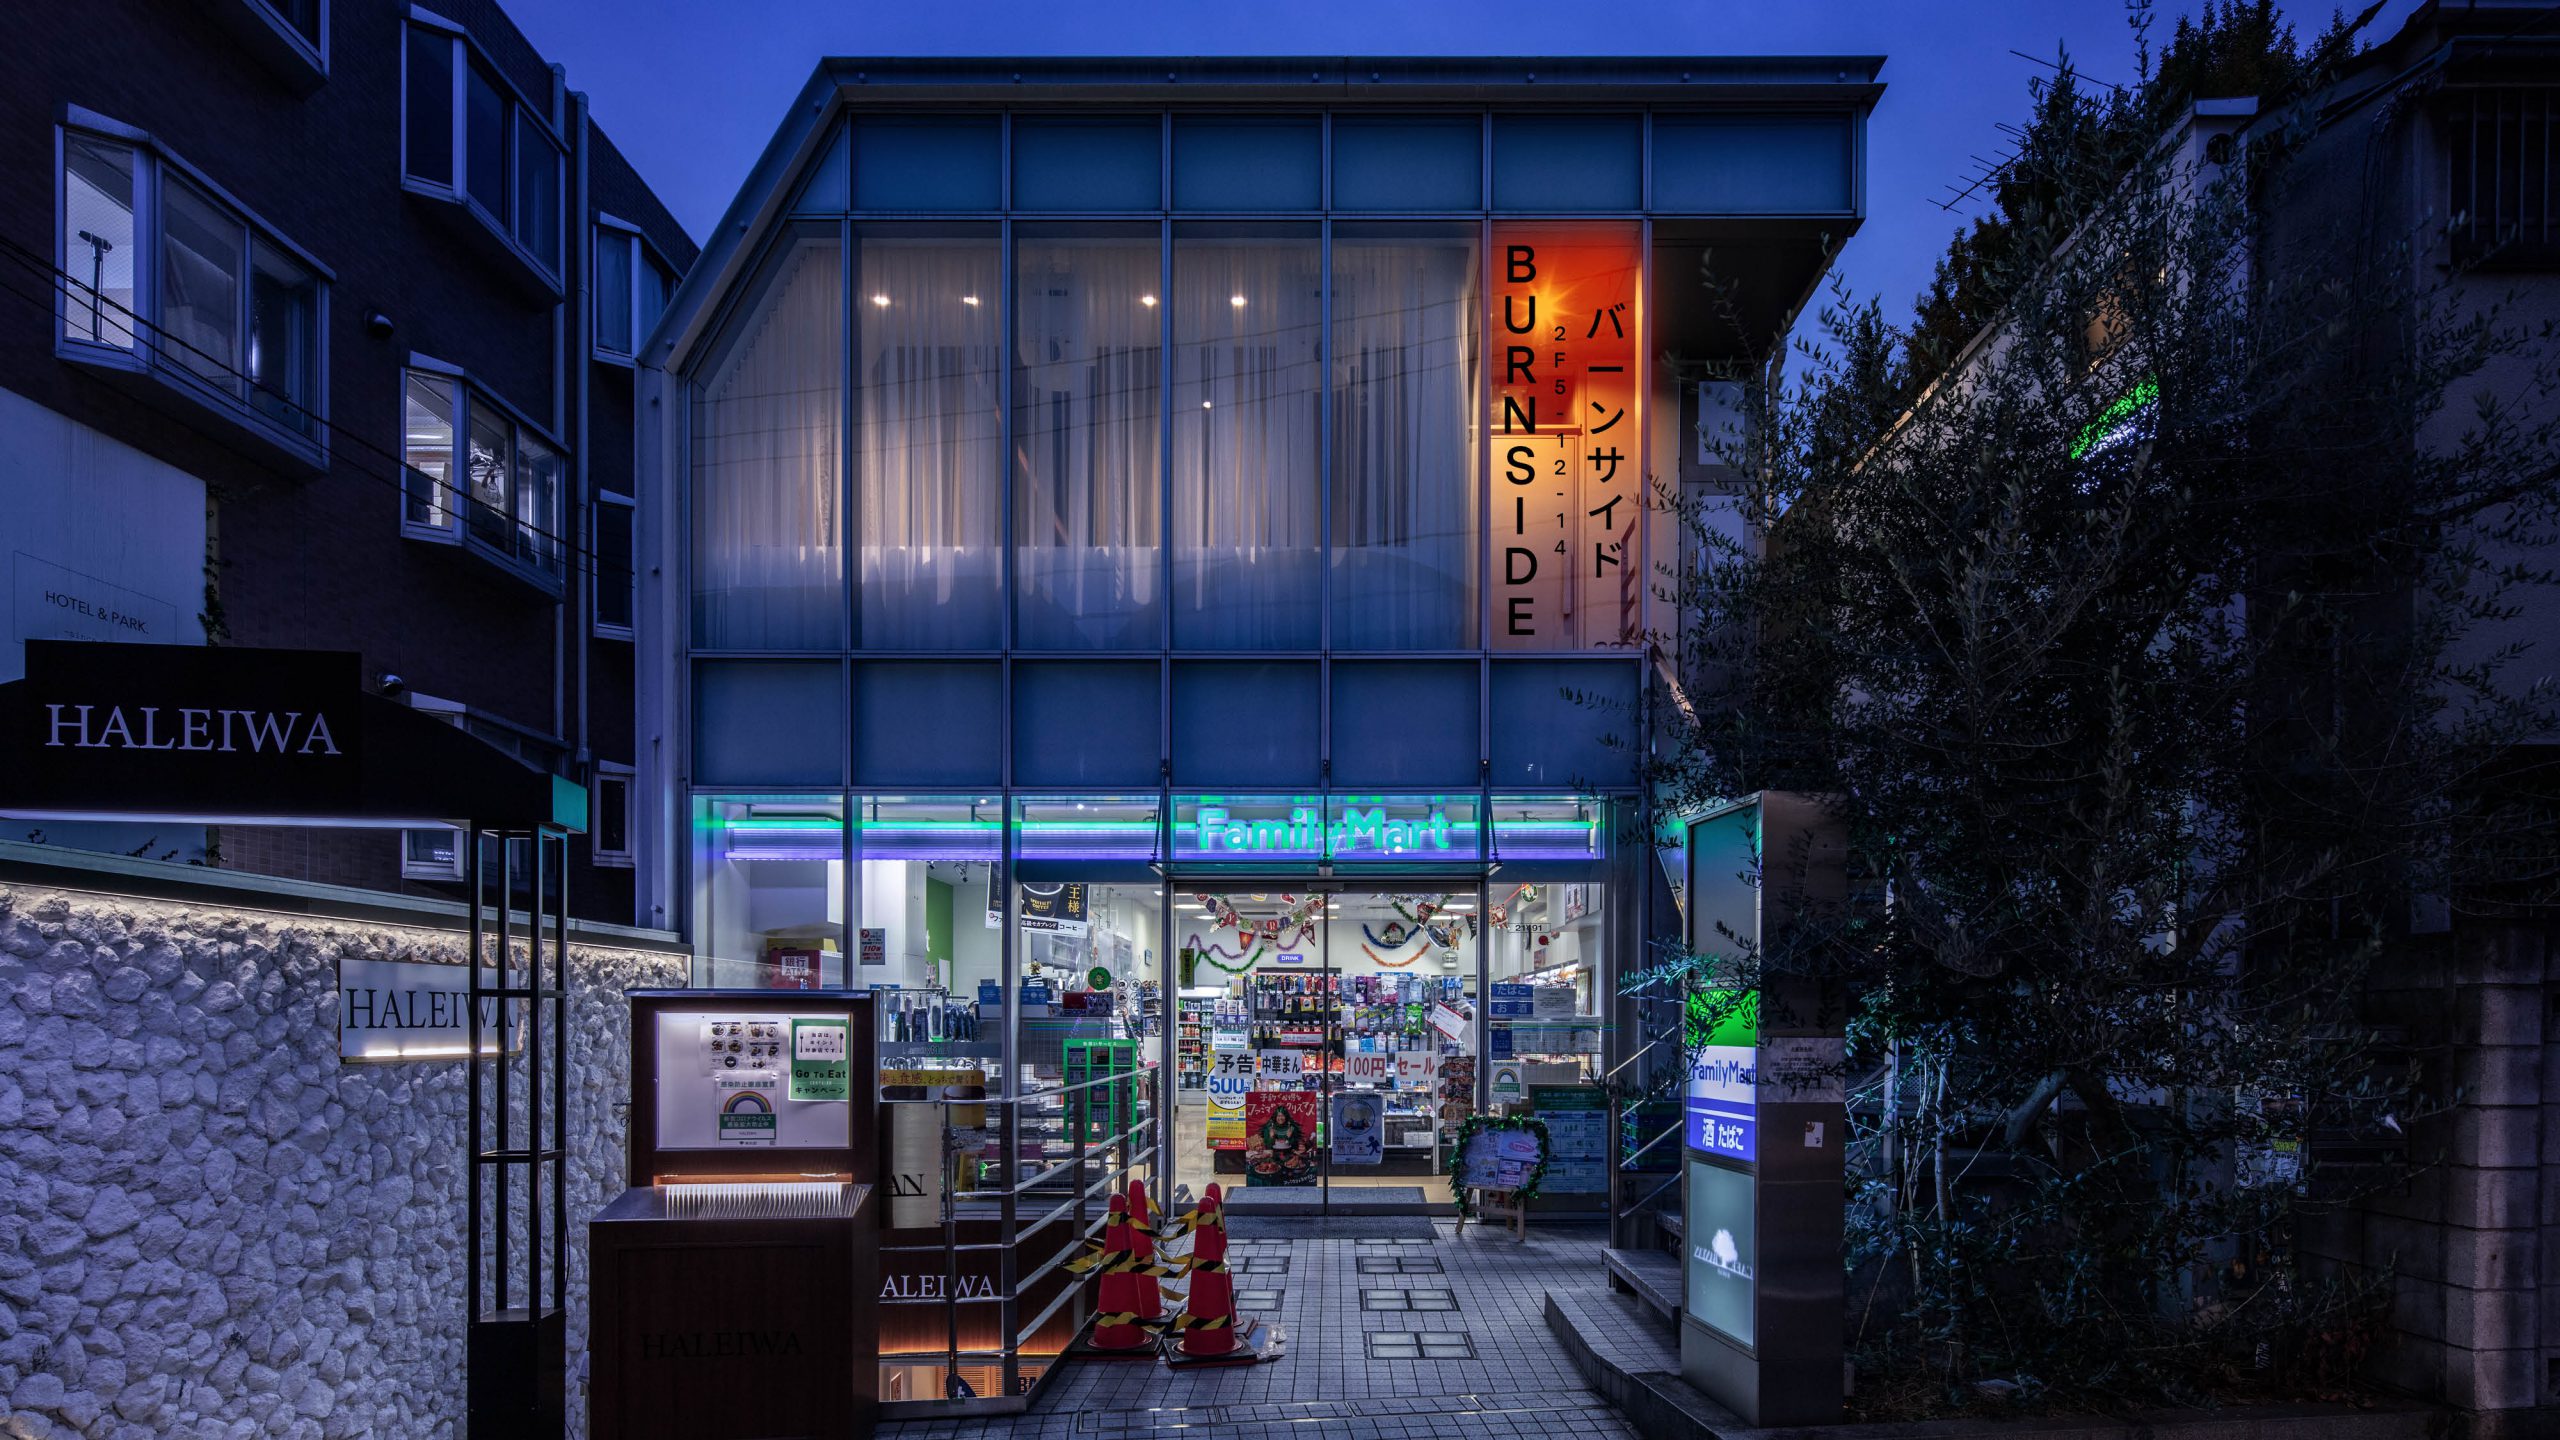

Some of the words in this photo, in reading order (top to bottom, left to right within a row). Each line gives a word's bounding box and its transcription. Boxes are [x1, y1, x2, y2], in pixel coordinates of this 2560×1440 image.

[1504, 245, 1537, 636] BURNSIDE
[1586, 302, 1626, 579] バーンサイド
[45, 590, 94, 618] HOTEL
[98, 607, 108, 620] &
[43, 703, 343, 756] HALEIWA
[1199, 808, 1450, 857] FamilyMart
[784, 957, 806, 967] 銀行
[785, 968, 806, 976] ATM
[1497, 985, 1528, 996] たばこ
[1217, 1053, 1255, 1074] 予告
[1262, 1055, 1301, 1074] 中華まん
[1347, 1057, 1386, 1077] 100円
[1397, 1056, 1435, 1075] セール
[796, 1070, 809, 1078] Go
[828, 1070, 846, 1078] Eat
[795, 1086, 845, 1094] キャンペーン
[1703, 1117, 1715, 1148] 酒
[1718, 1123, 1744, 1151] たばこ
[640, 1332, 805, 1358] HALEIWA
